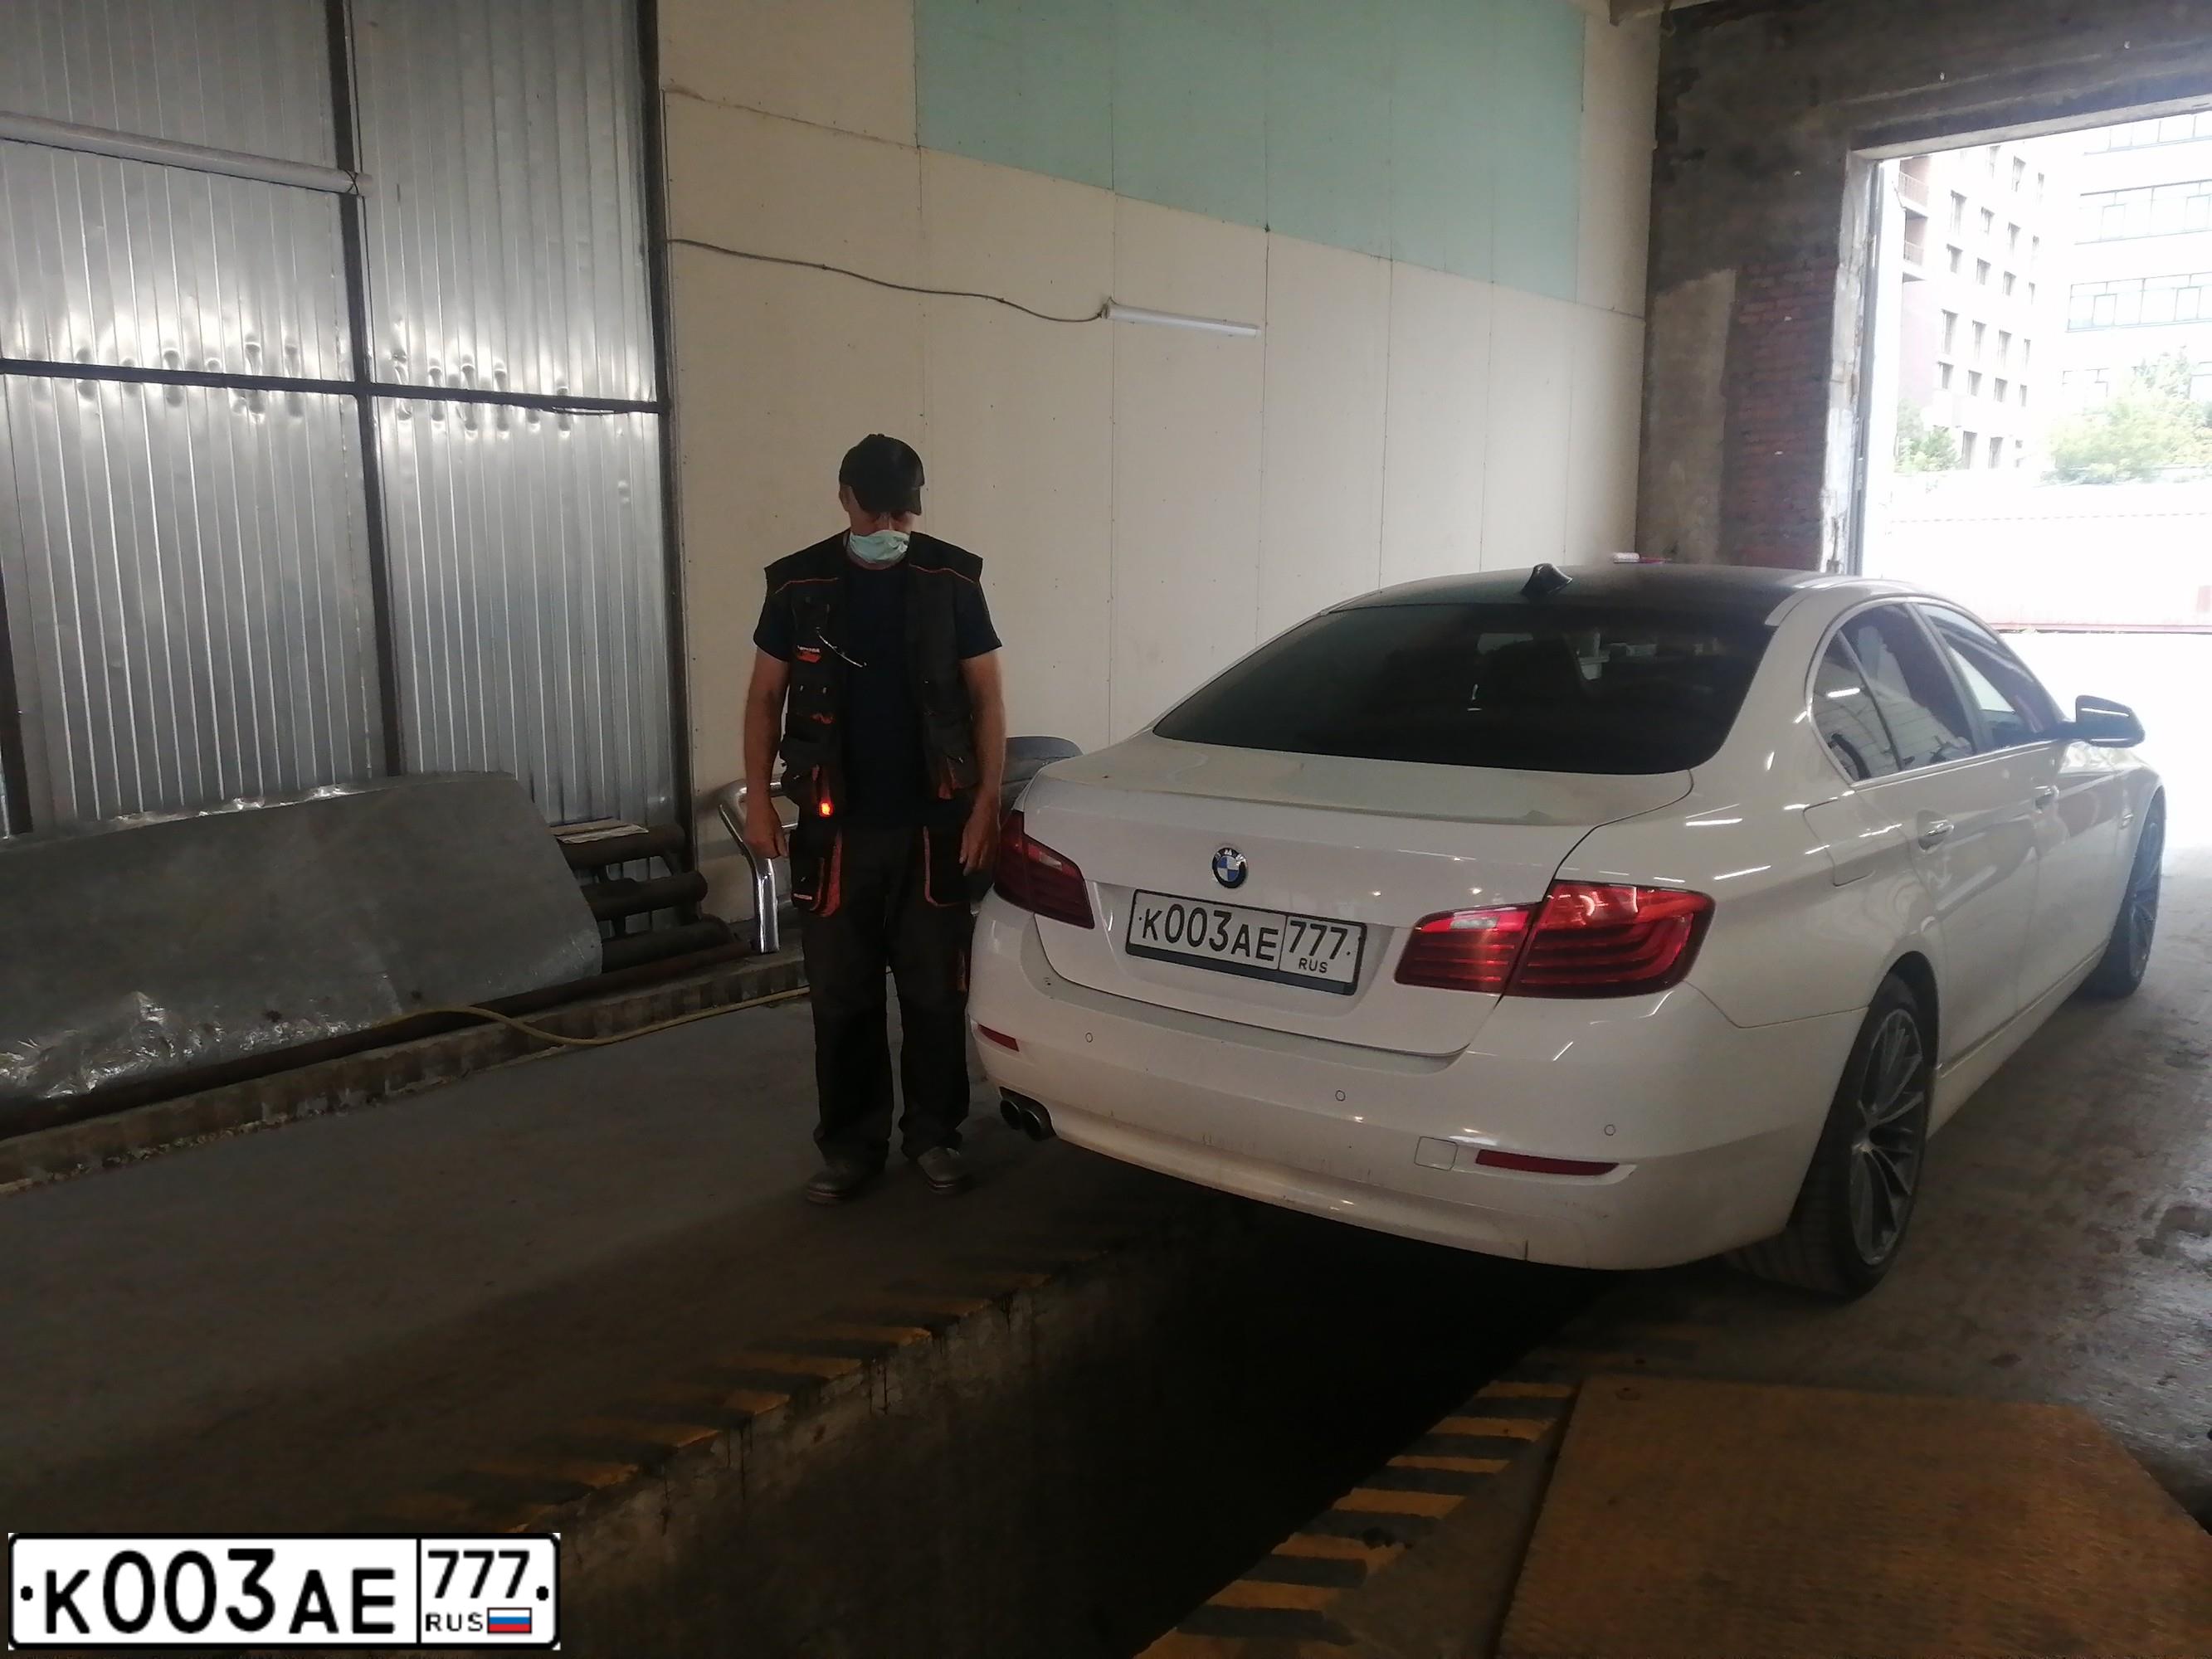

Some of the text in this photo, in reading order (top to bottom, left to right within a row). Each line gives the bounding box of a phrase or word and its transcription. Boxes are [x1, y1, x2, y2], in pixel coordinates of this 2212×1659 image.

[1142, 903, 1348, 961] K003AE 777
[1298, 957, 1328, 973] RUS
